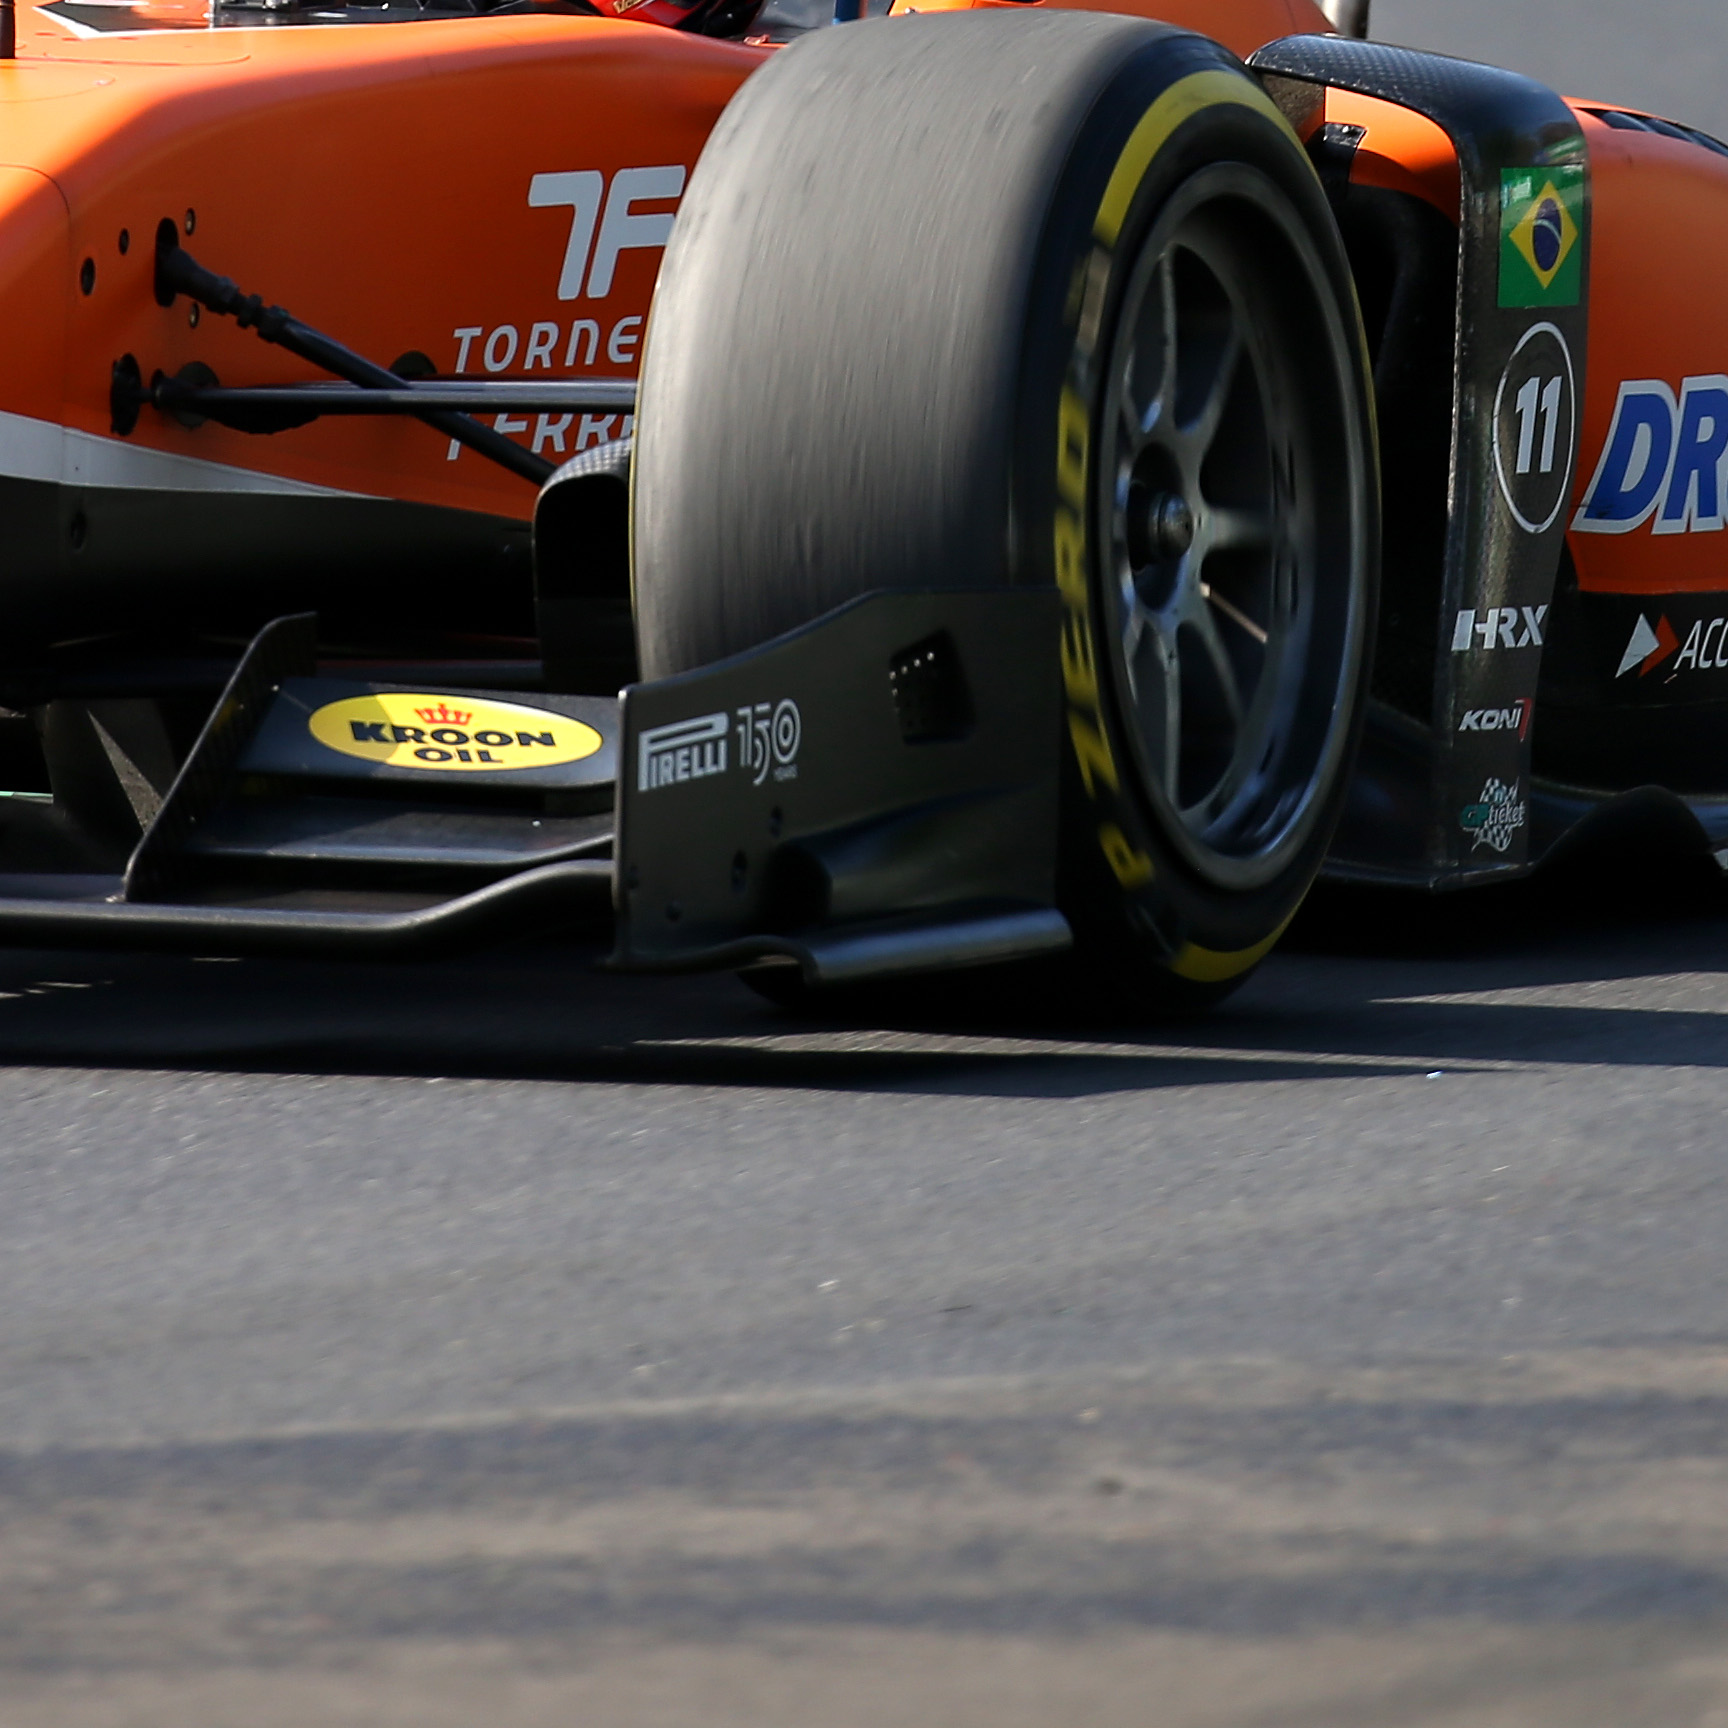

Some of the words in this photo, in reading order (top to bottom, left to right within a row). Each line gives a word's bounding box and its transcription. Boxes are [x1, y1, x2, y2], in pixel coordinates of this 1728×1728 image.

[1514, 375, 1563, 475] 11
[1458, 706, 1523, 732] KONI
[349, 720, 557, 748] KROON
[414, 746, 504, 764] OIL
[638, 711, 730, 792] PIRELLI
